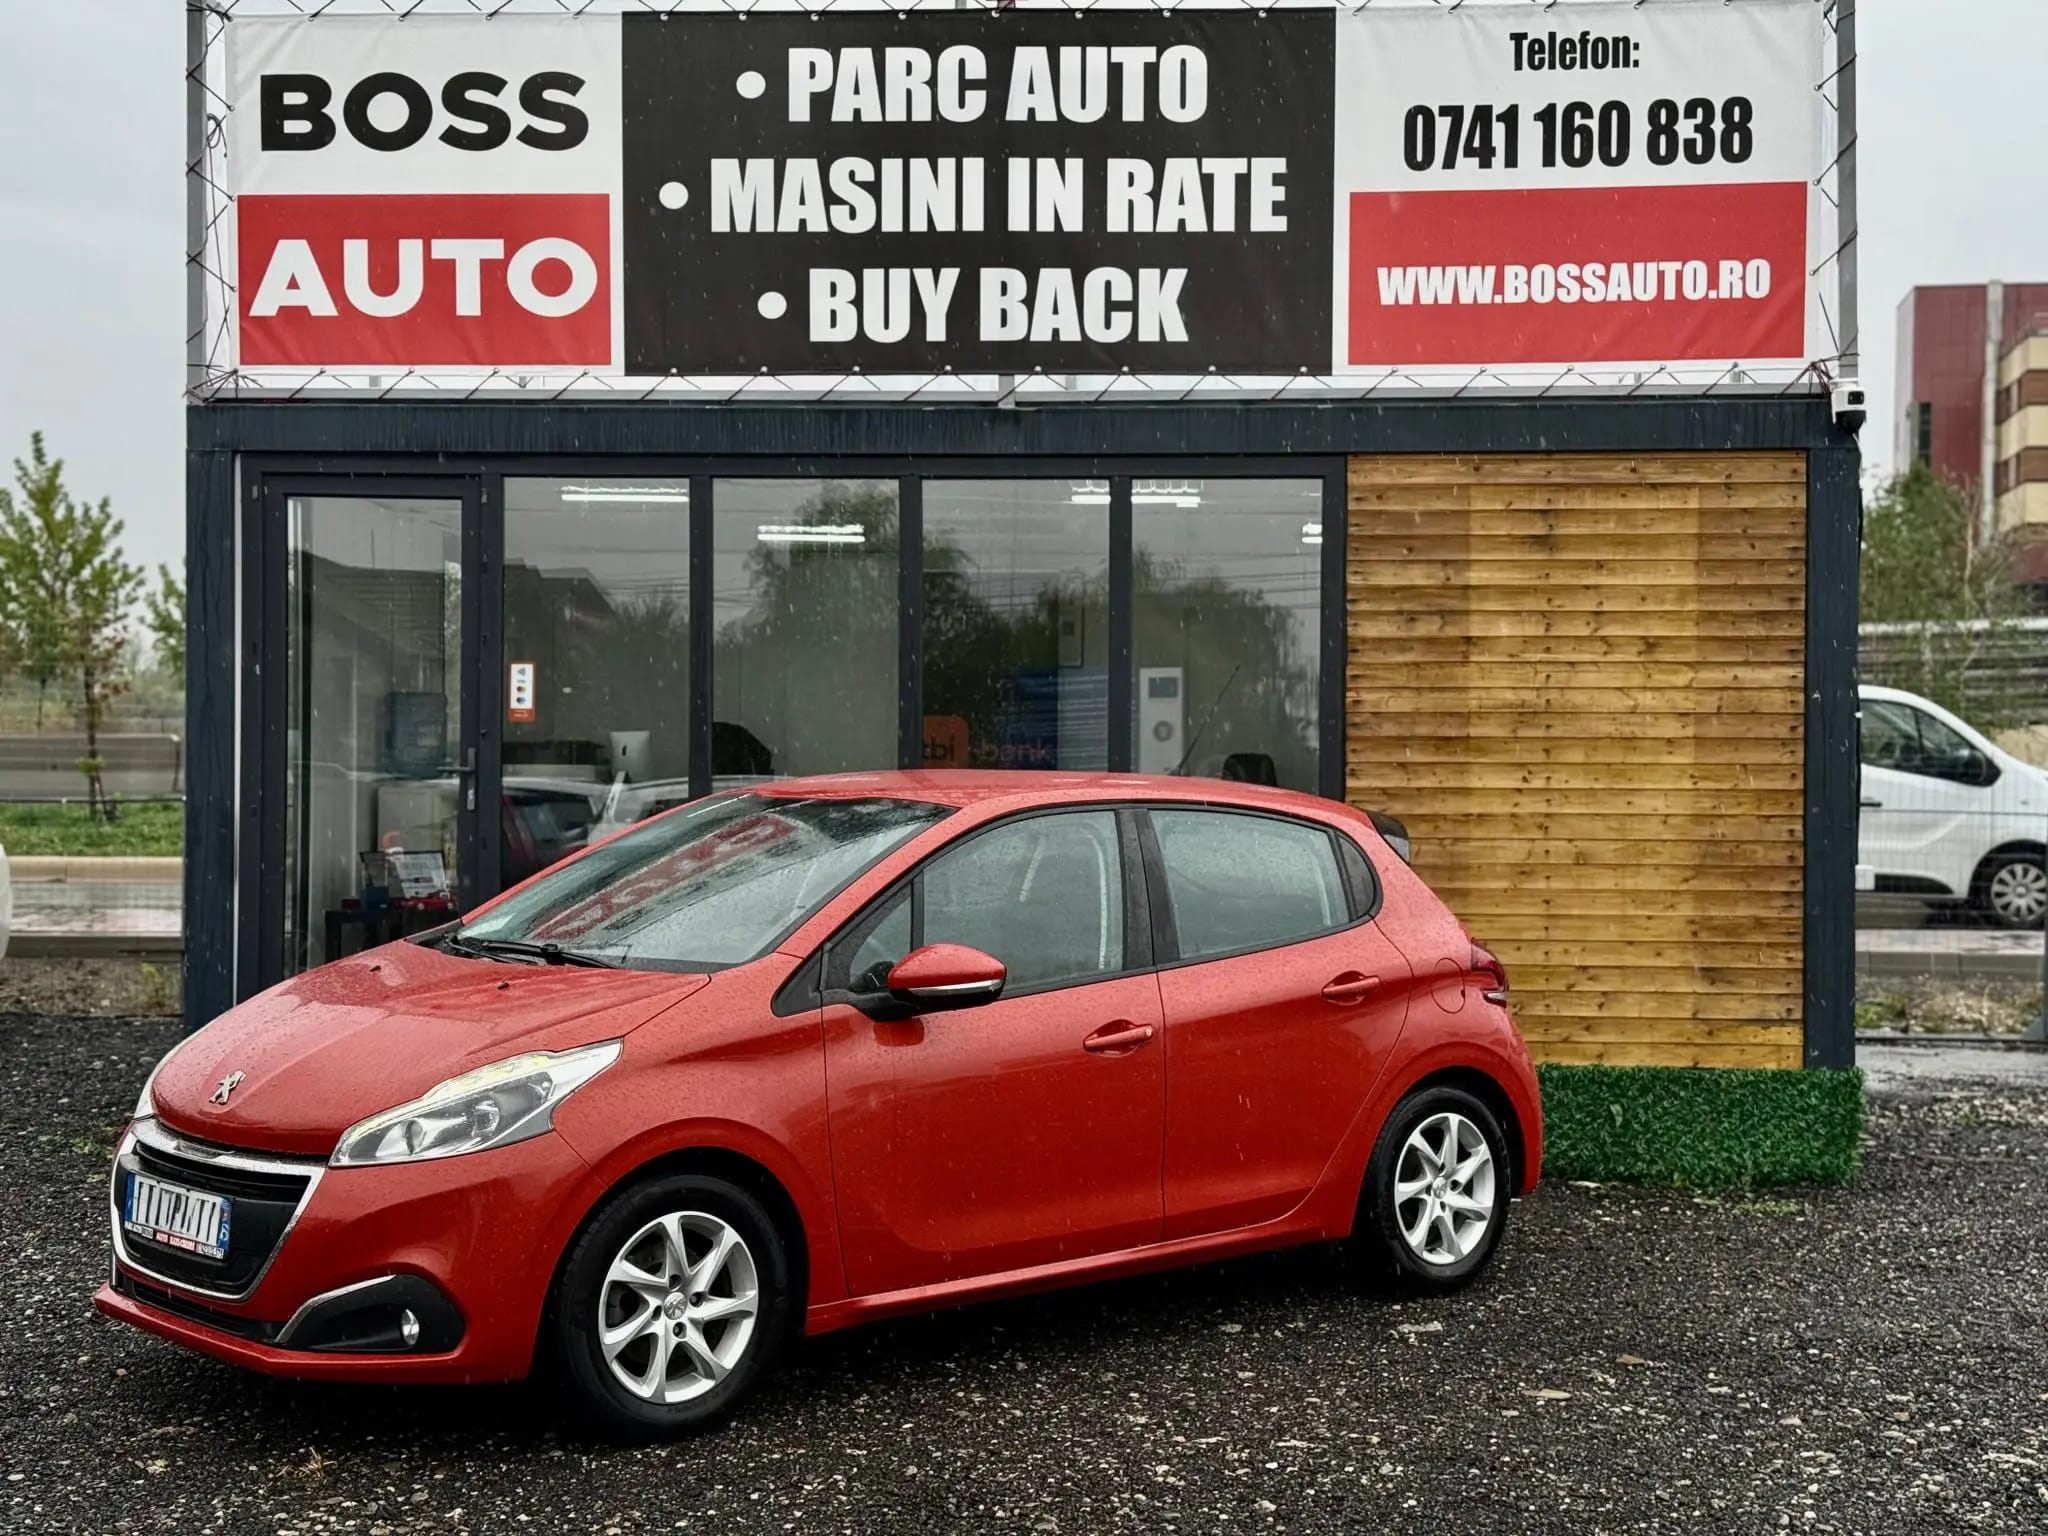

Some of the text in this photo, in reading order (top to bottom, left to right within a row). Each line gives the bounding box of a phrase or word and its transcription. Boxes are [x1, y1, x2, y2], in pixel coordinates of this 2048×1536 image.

[789, 45, 1207, 122] PARC AUTO
[1510, 31, 1639, 70] Telefon:
[261, 72, 588, 151] BOSS
[1405, 97, 1752, 171] 0741 160 838
[711, 157, 1287, 233] MASINI IN RATE
[249, 238, 597, 317] AUTO
[810, 267, 1188, 342] BUY BACK
[1377, 259, 1770, 305] WWW.BOSSAUTO.RO
